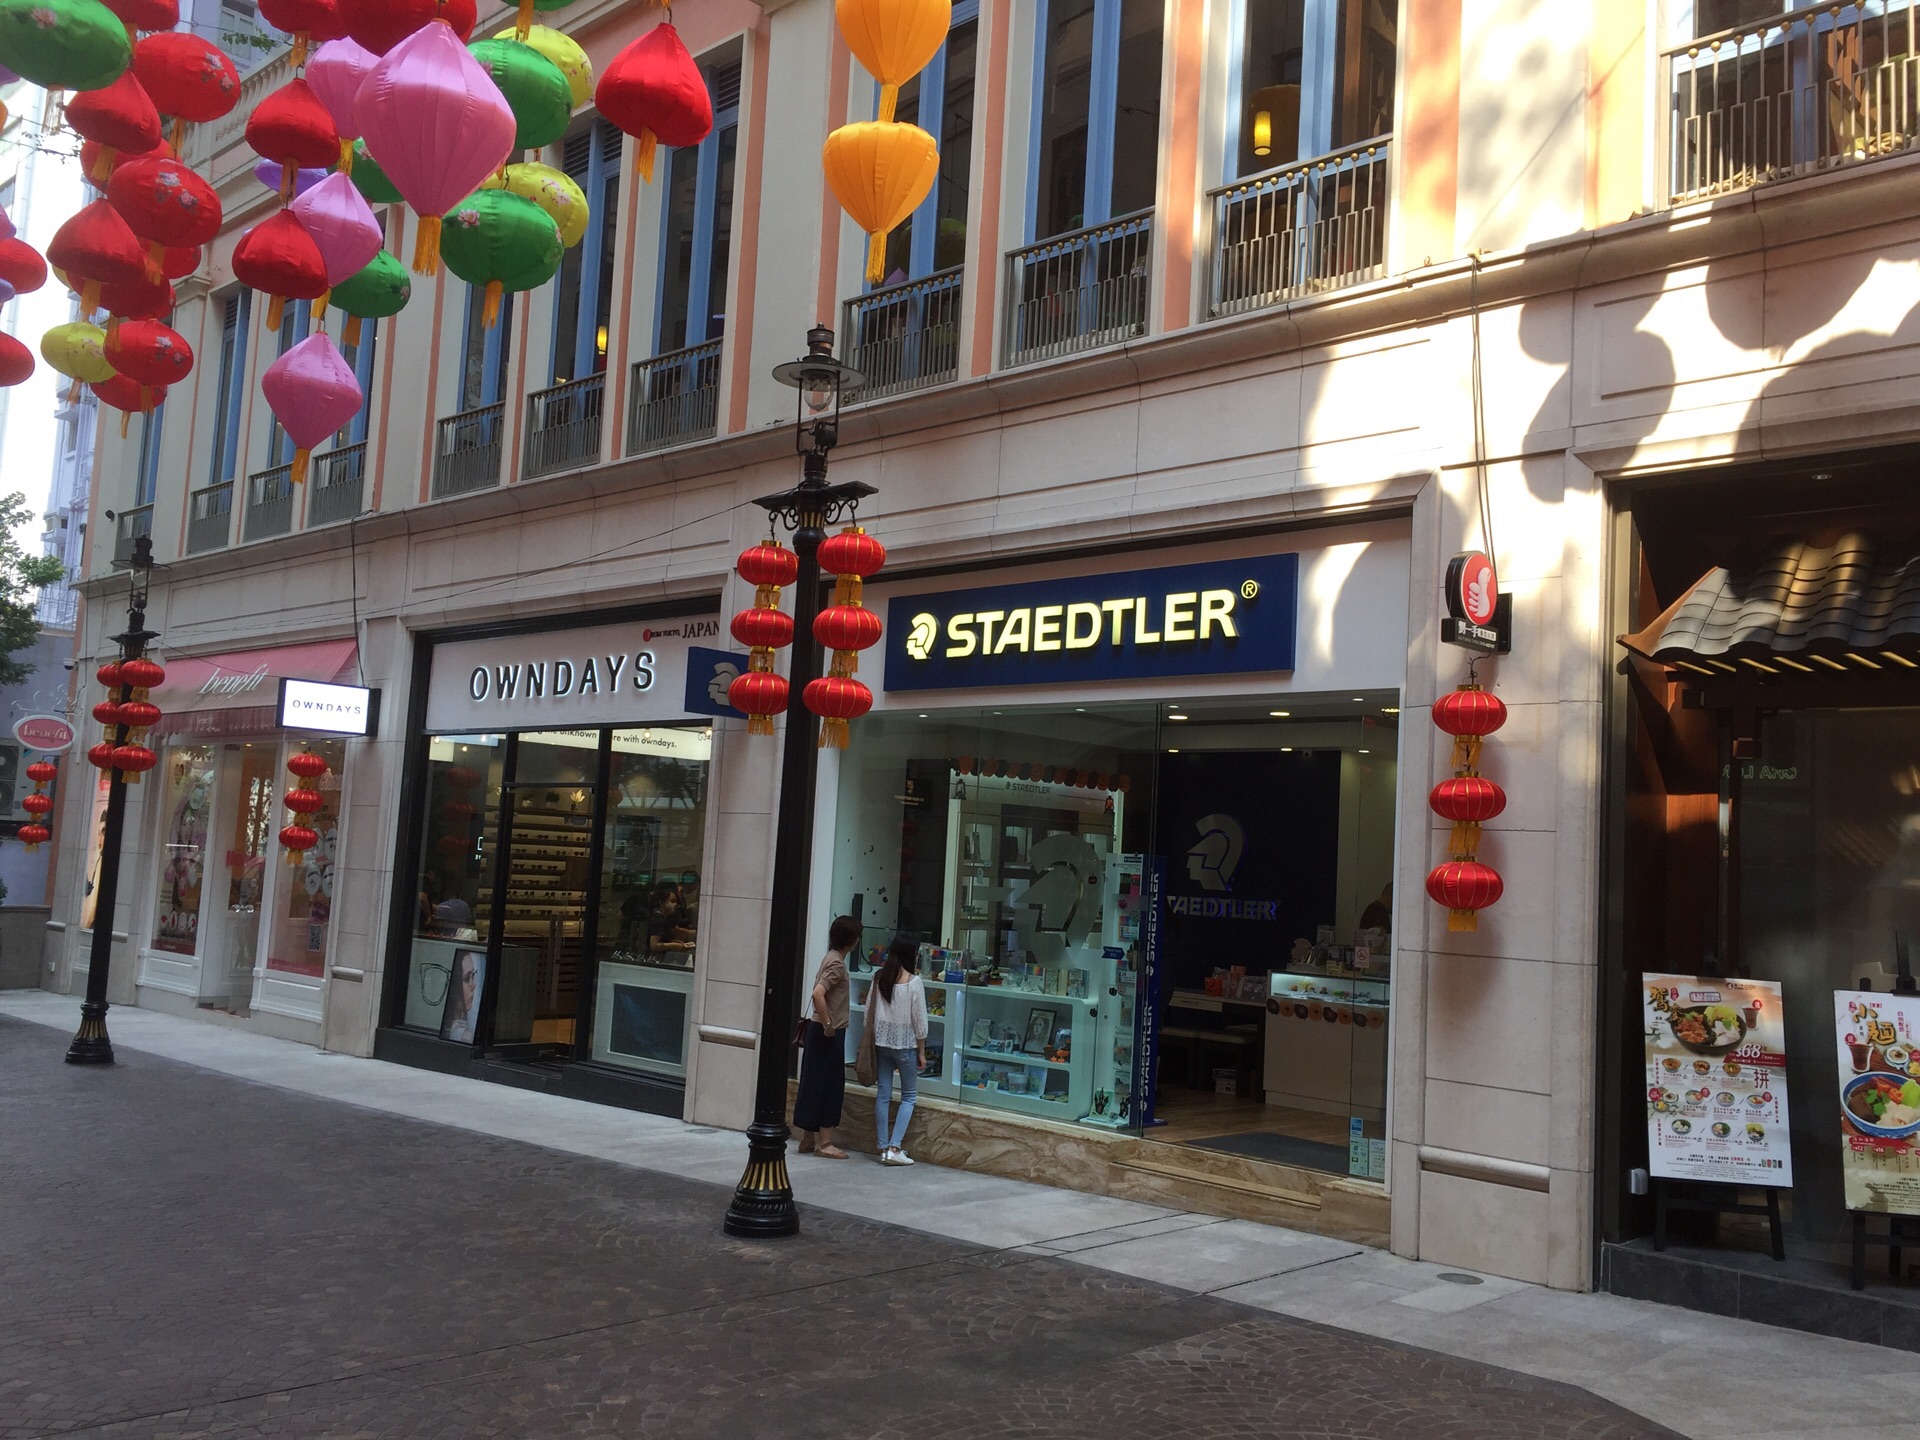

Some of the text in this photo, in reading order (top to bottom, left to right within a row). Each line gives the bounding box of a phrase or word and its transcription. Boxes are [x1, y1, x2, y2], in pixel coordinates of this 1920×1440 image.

[682, 620, 720, 639] JAPAN
[945, 588, 1240, 659] STAEDTLER
[198, 663, 270, 699] benefit
[469, 651, 656, 702] OWNDAYS
[292, 699, 361, 715] OWNDAYS
[23, 724, 68, 740] benefit
[623, 734, 640, 744] with
[641, 737, 677, 750] owndays.
[1012, 782, 1051, 795] STAEDTLER
